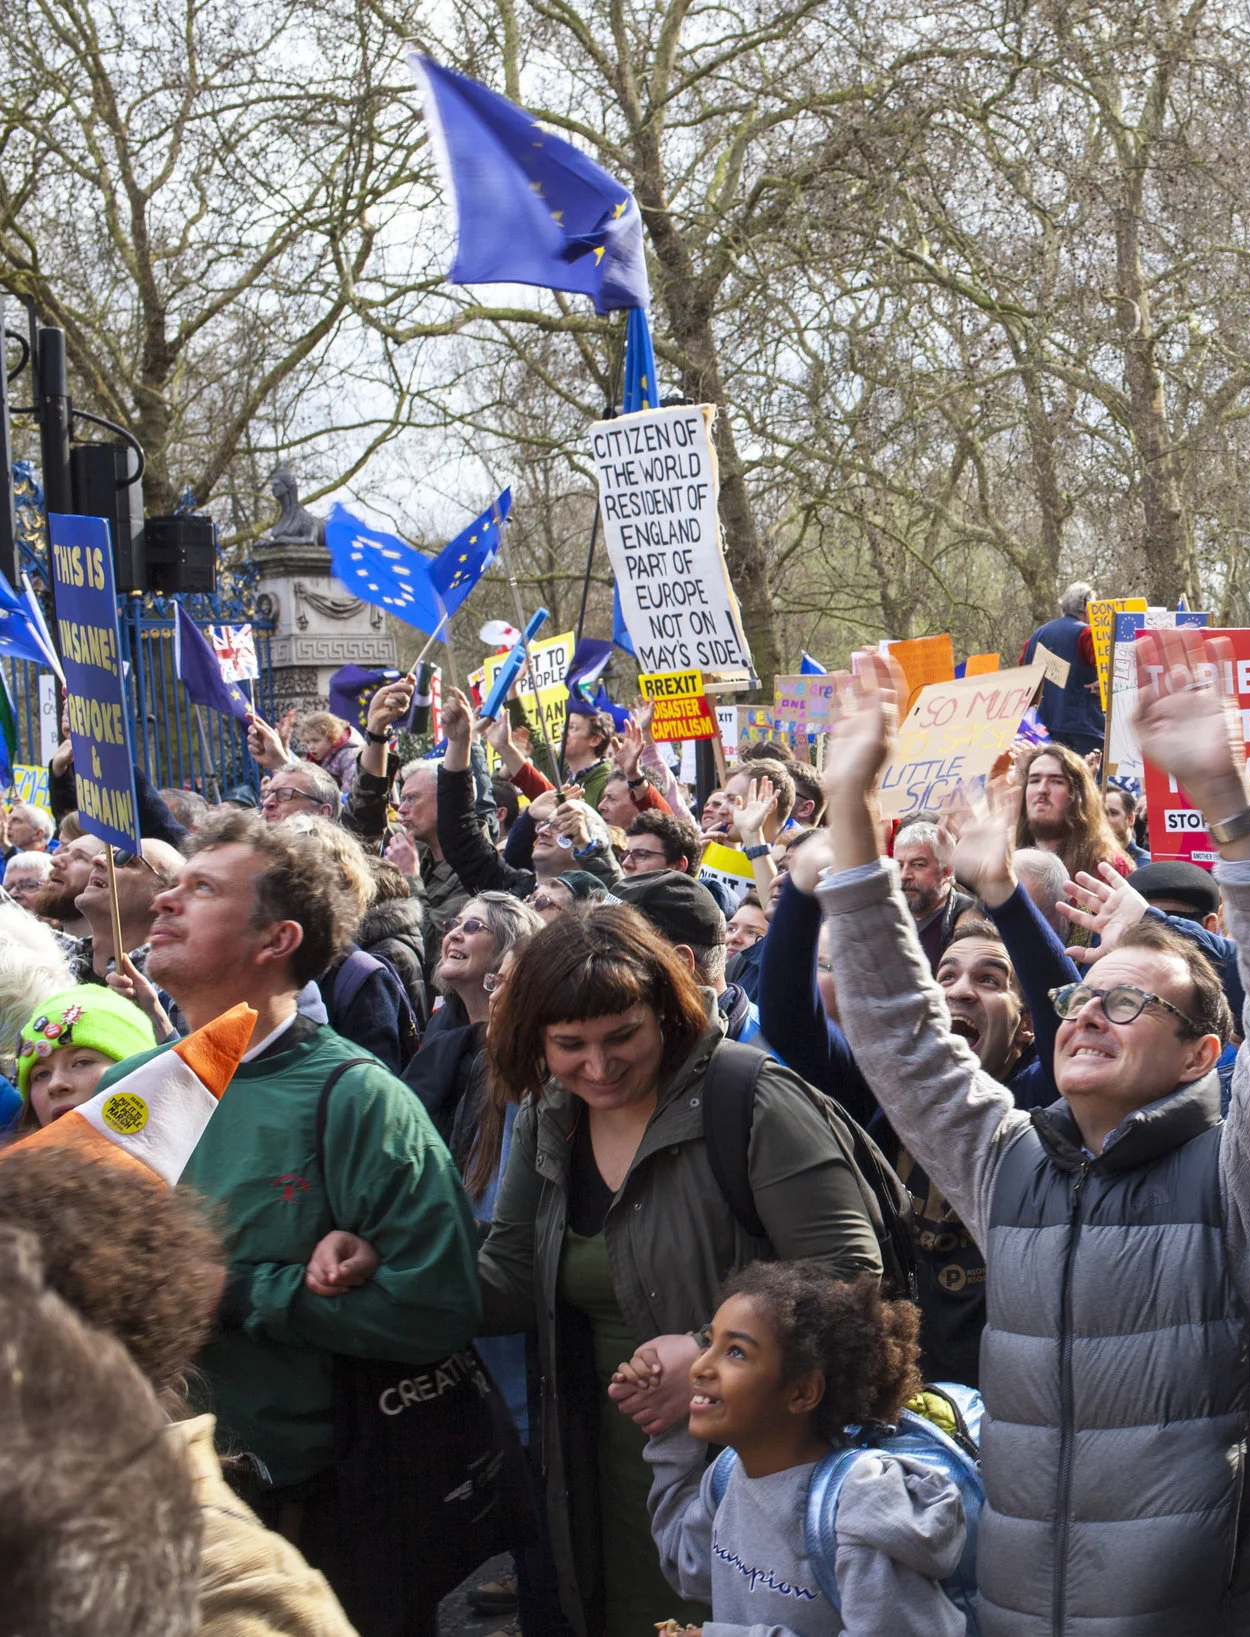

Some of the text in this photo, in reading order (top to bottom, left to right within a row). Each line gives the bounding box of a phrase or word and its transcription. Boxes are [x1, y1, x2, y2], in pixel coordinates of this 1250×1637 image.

[594, 418, 698, 459] CITIZEN OF
[600, 452, 700, 490] THE WORLD
[604, 483, 709, 520] RESIDENT OF
[620, 517, 701, 550] ENGLAND
[54, 544, 105, 590] THIS IS
[625, 549, 693, 580] PART OF
[636, 579, 708, 610] EUROPE
[1091, 600, 1127, 615] DON'T
[649, 610, 717, 639] NOT ON
[1094, 617, 1111, 628] SIG
[59, 619, 117, 677] INSANE!
[639, 610, 748, 670] MAY'S SIDE!
[549, 647, 565, 671] TO
[520, 666, 566, 693] PEOPLE
[644, 675, 697, 697] BREXIT
[68, 693, 124, 745] REVOKE
[654, 698, 700, 719] DISASTER
[919, 686, 1035, 728] SO MUCH
[651, 716, 714, 740] CAPITALISM
[91, 745, 102, 779] &
[882, 756, 967, 789] LITTLE
[75, 773, 135, 840] REMAIN!
[1168, 813, 1206, 829] STO
[713, 1529, 819, 1600] hampion
